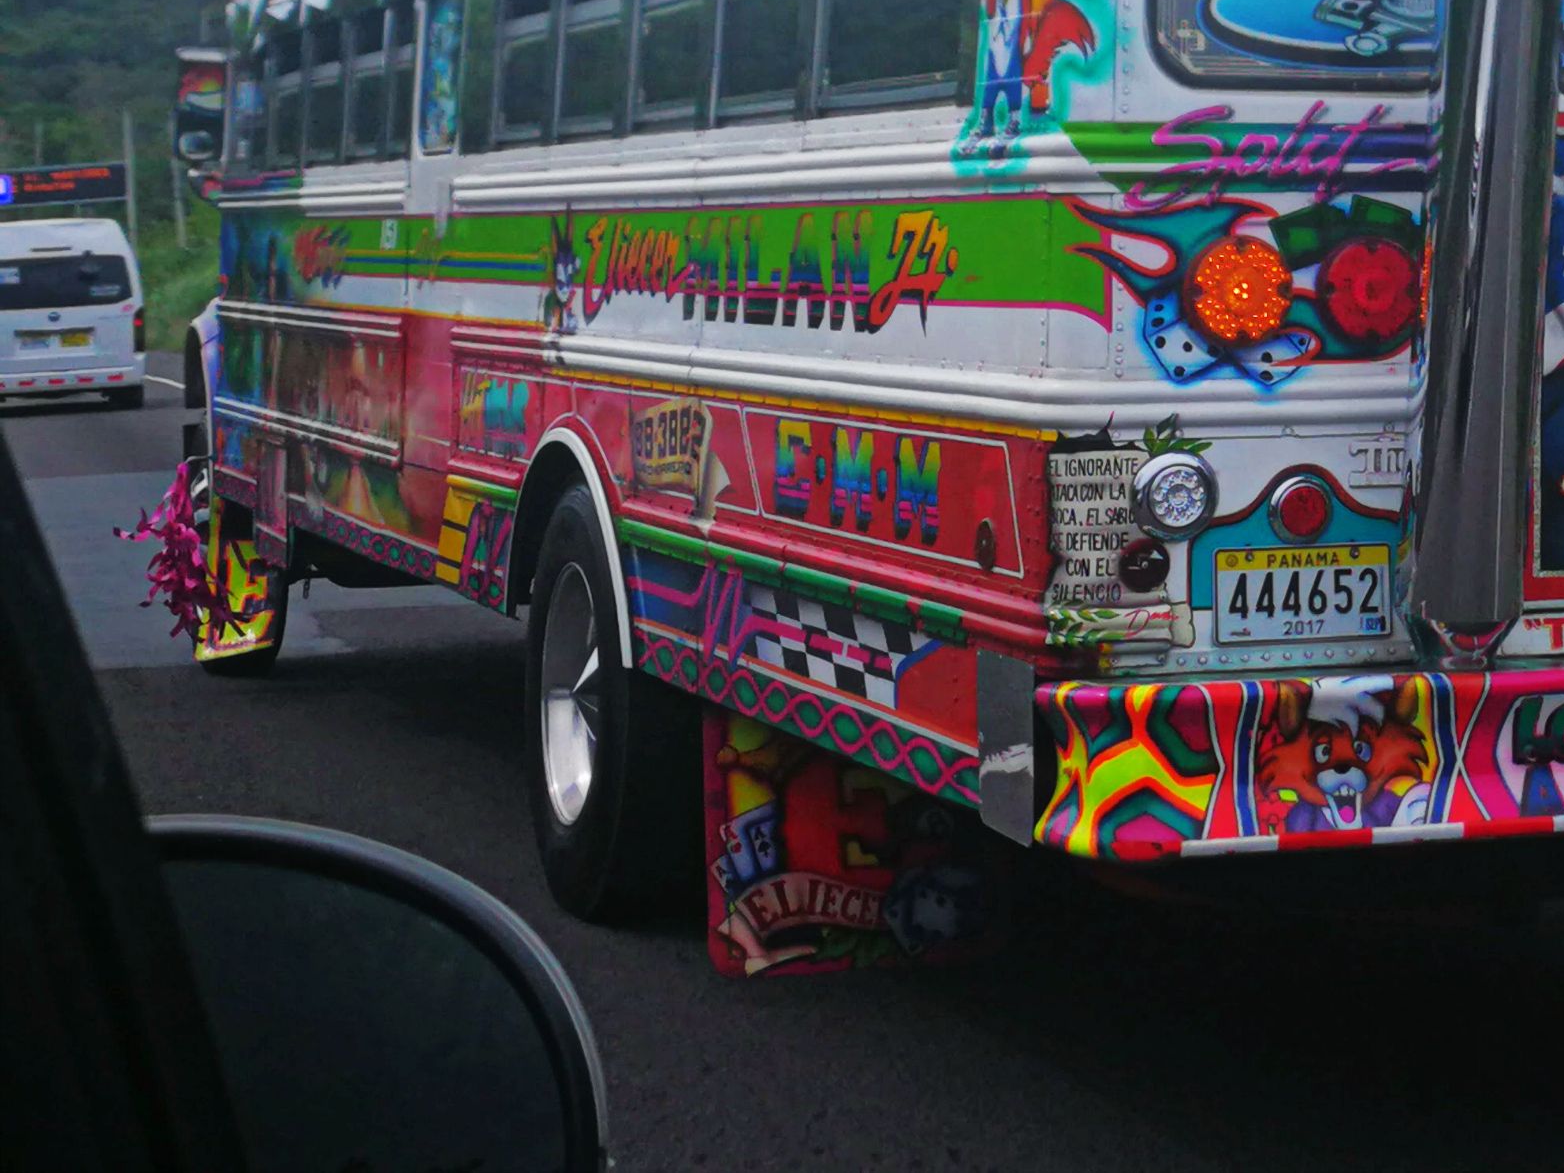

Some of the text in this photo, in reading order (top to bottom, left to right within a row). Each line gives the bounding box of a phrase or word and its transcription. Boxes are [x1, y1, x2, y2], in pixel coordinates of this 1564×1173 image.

[583, 216, 700, 326] Eliecer
[683, 209, 873, 332] MILAN
[1064, 458, 1139, 478] IGNORANTE
[1079, 483, 1103, 501] CON
[1109, 483, 1127, 500] LA
[1086, 509, 1102, 526] EL
[1066, 532, 1129, 551] DEFIENDE
[1066, 558, 1117, 577] CON EL
[1267, 552, 1341, 569] PANAMA
[1051, 583, 1123, 602] SILENCIO
[1229, 568, 1380, 619] 444652
[1283, 620, 1325, 636] 2017
[746, 878, 890, 933] ELIECE
